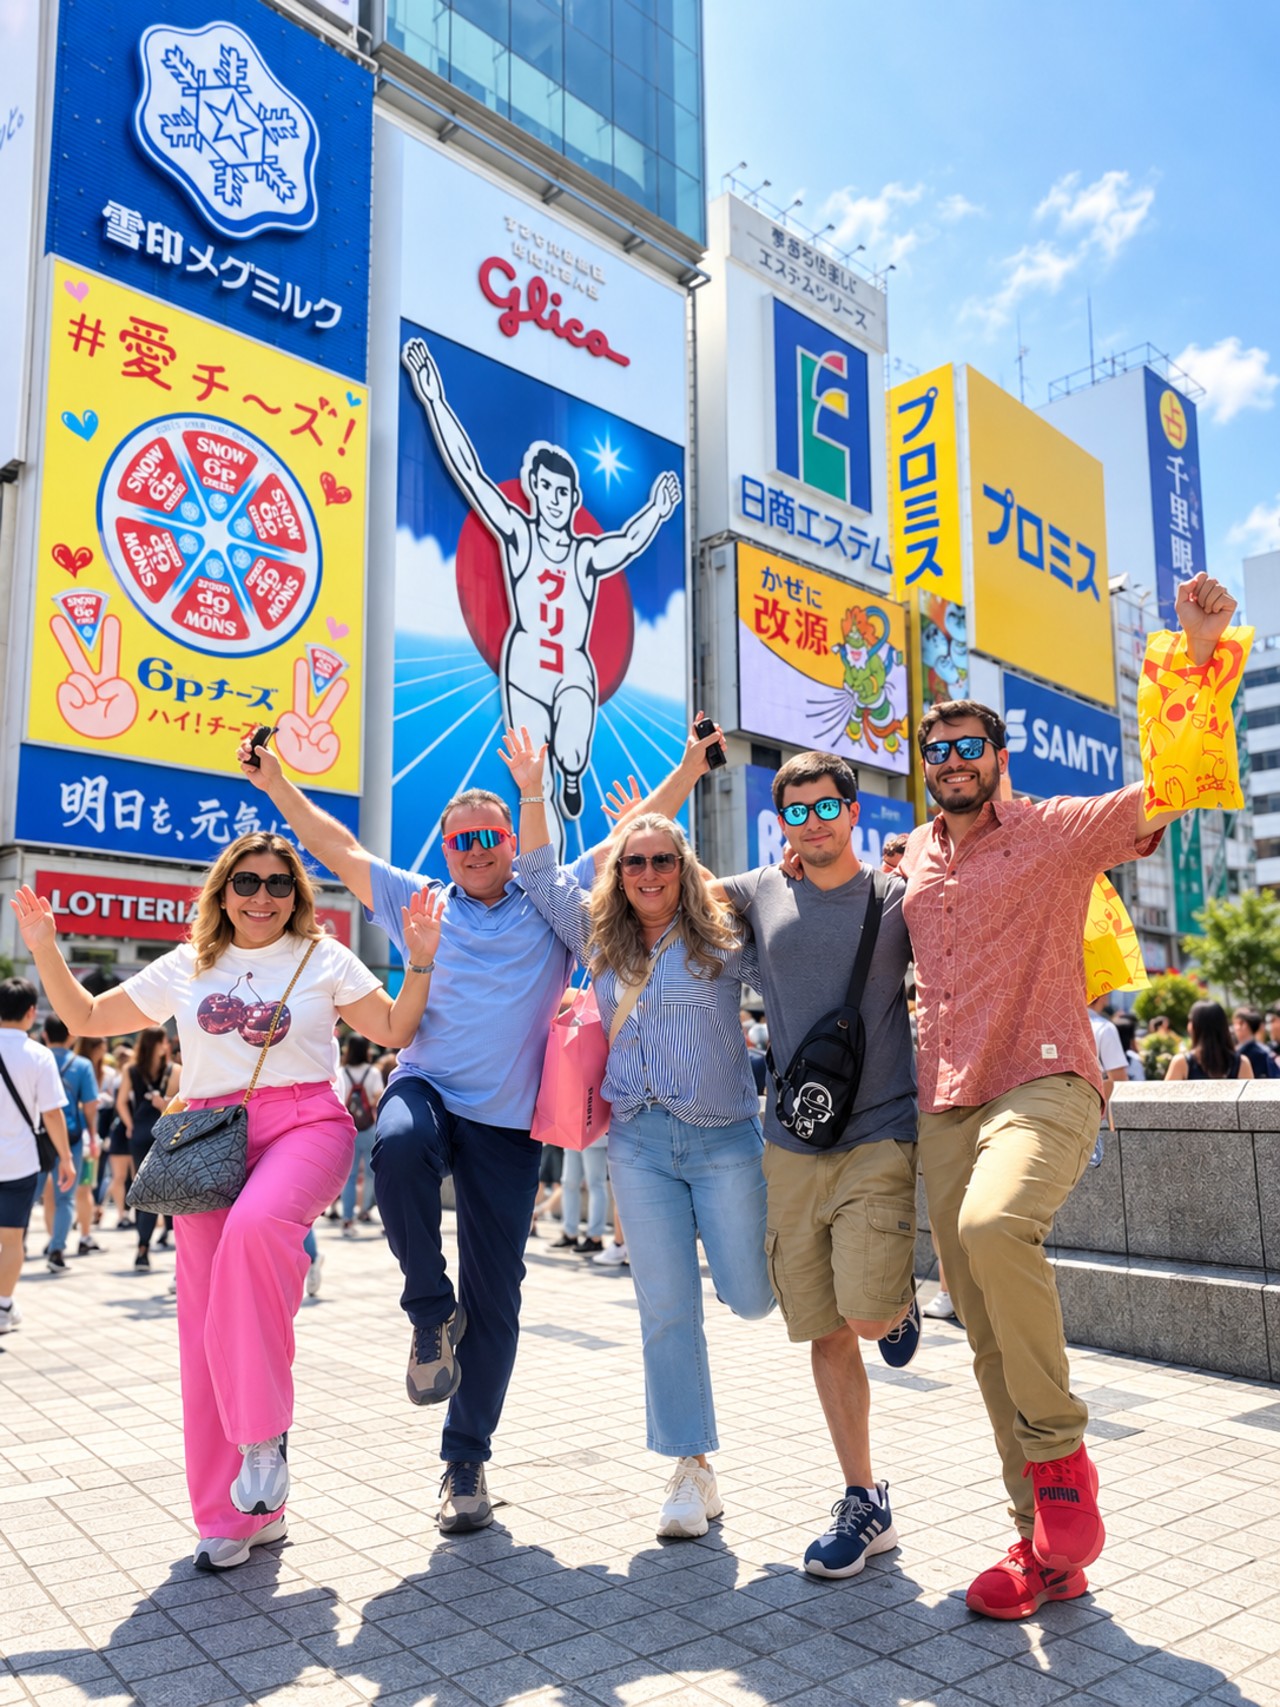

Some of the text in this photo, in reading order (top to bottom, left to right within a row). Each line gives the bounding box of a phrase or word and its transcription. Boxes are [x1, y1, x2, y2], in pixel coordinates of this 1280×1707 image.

[102, 200, 342, 329] 雪印メグミルク
[479, 256, 630, 367] Glico
[126, 444, 165, 494] SNOW
[196, 436, 248, 465] SNOW
[271, 488, 301, 540] SNOW
[898, 386, 943, 586] プロミス
[741, 474, 893, 575] 日商エステム
[983, 483, 1100, 602] プロミス
[1166, 455, 1194, 598] 千里眼
[122, 531, 158, 588] SNOW
[761, 566, 823, 609] かぜに
[183, 609, 237, 637] SNOW
[267, 575, 300, 622] SNOW
[537, 568, 567, 675] グリコ
[754, 593, 829, 656] 改源
[138, 657, 279, 711] 6pチーズ
[1032, 718, 1118, 781] SAMTY
[51, 889, 199, 924] LOTTERIA
